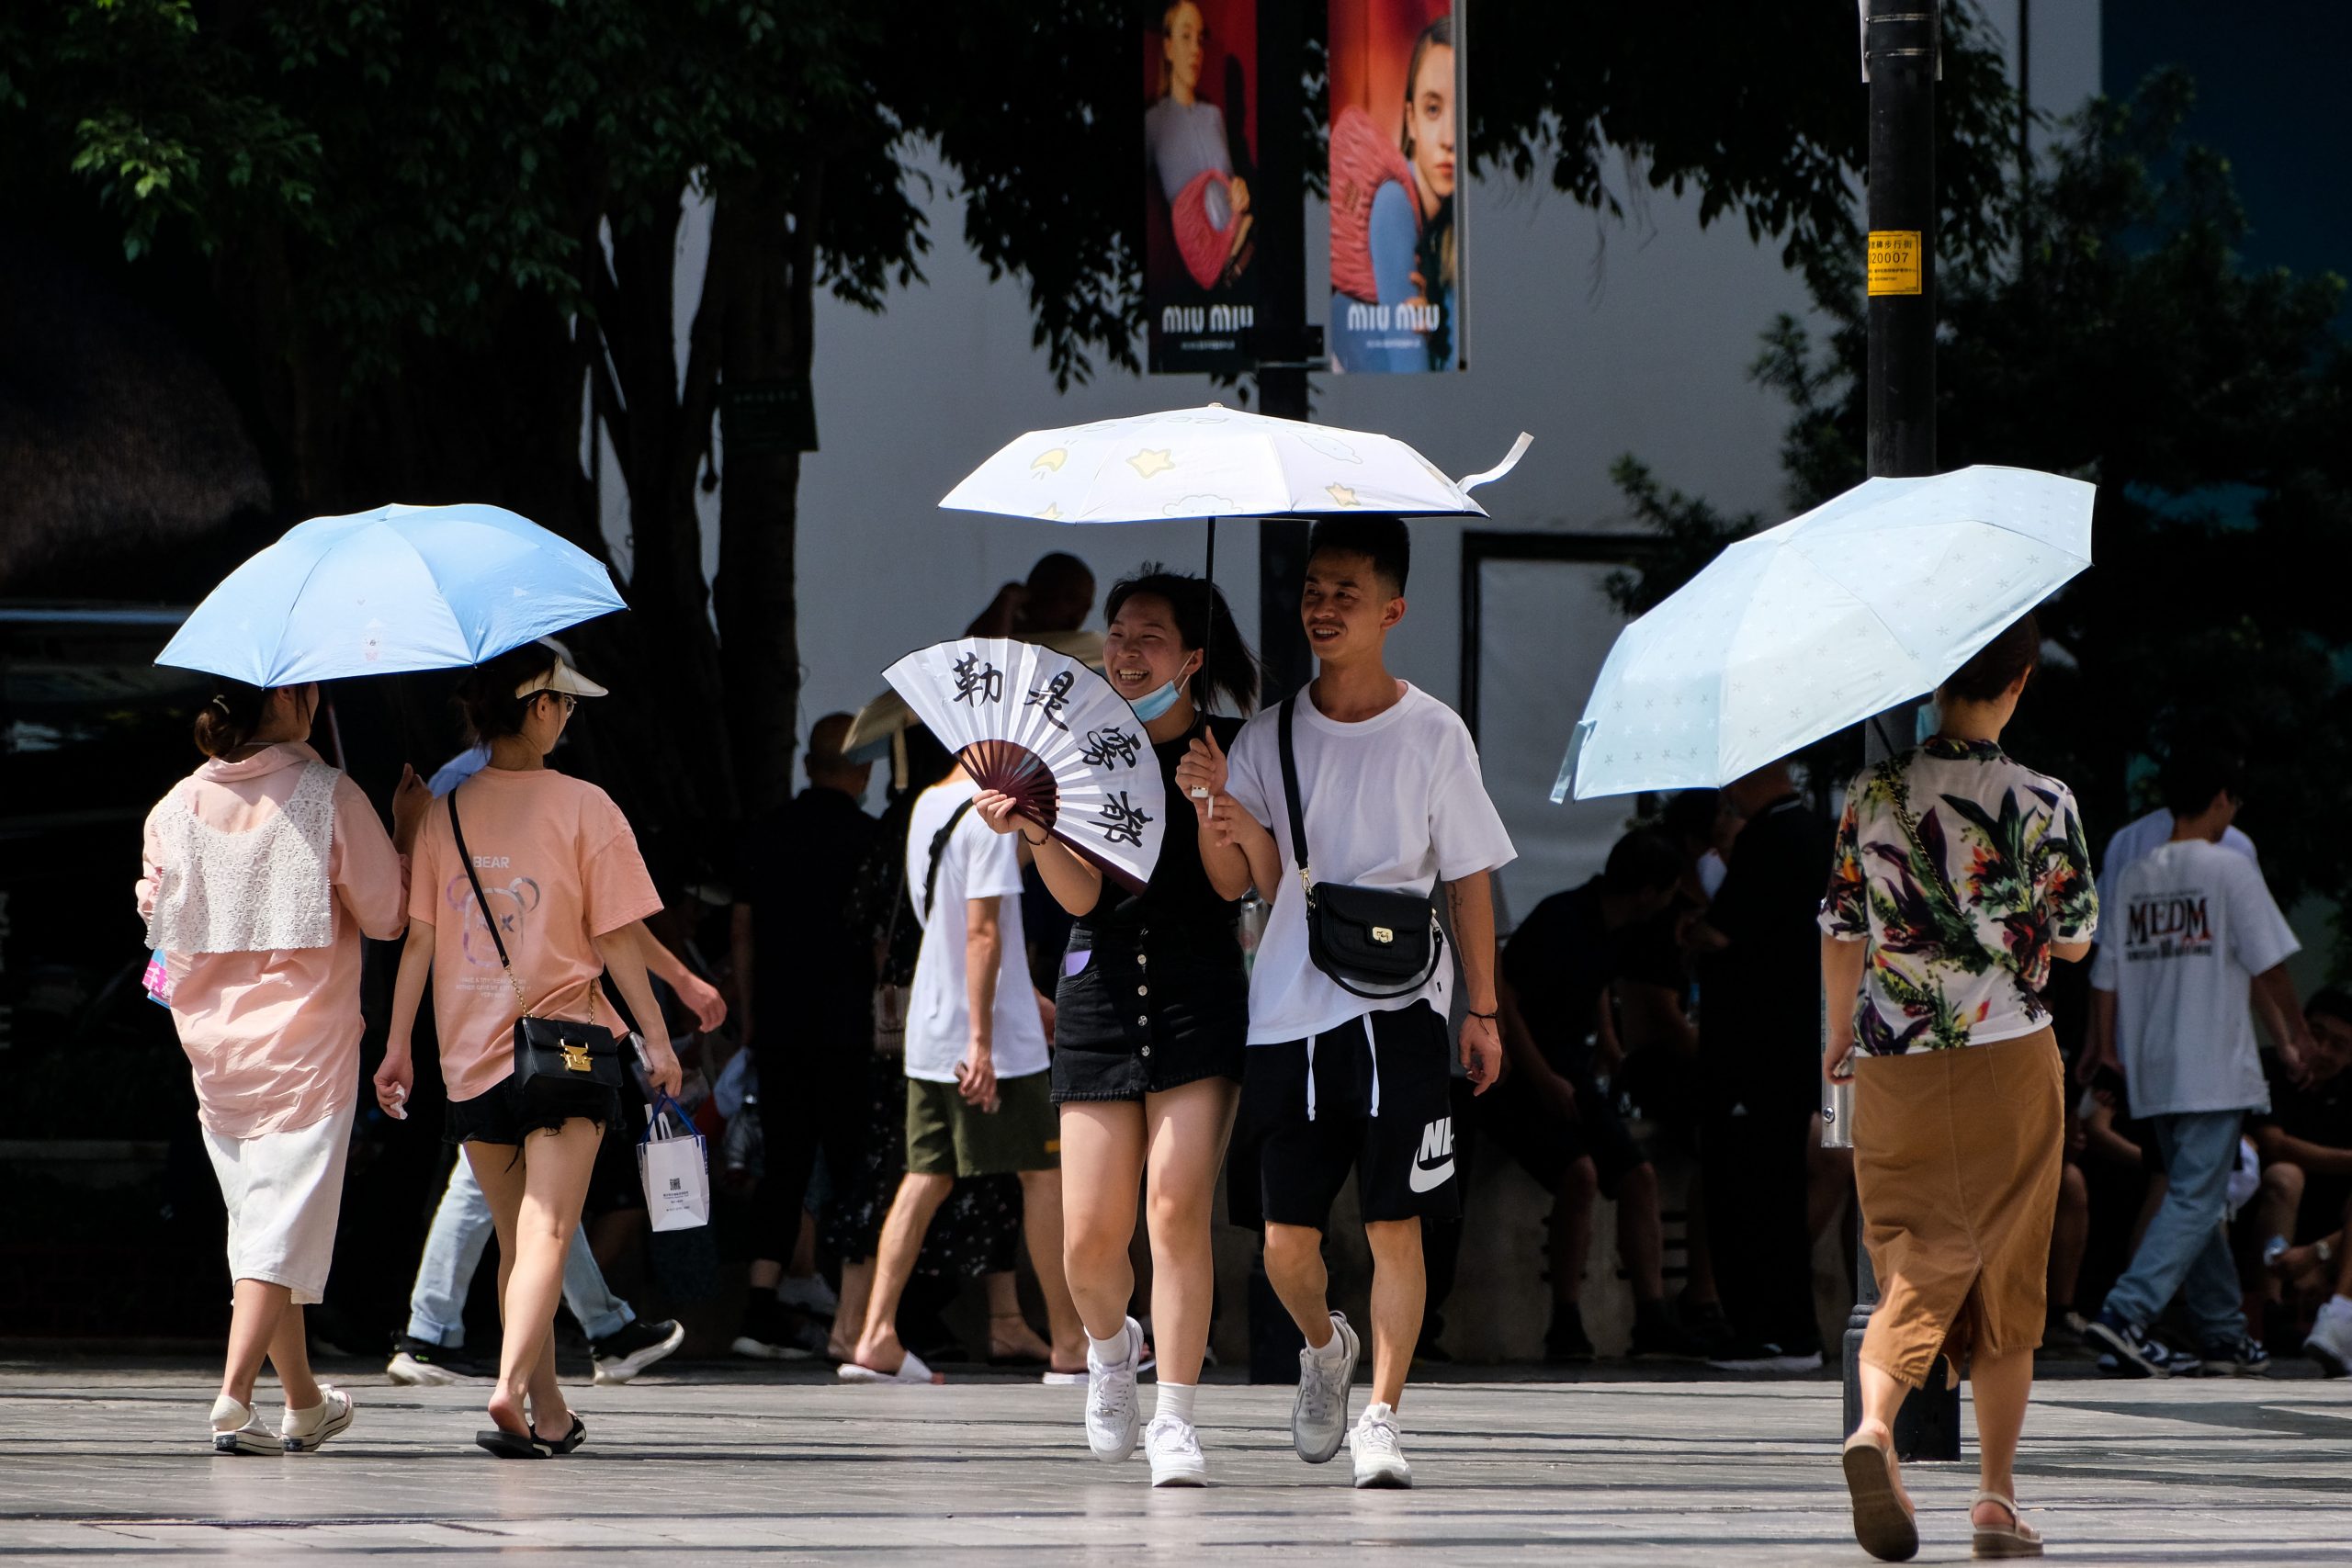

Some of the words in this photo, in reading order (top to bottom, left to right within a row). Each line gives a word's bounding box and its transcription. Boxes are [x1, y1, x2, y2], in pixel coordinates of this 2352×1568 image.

[1162, 305, 1204, 334] MIU
[1209, 304, 1254, 333] MIU
[1348, 303, 1390, 332] MIU
[1396, 303, 1440, 332] MIU
[473, 856, 510, 869] BEAR
[1419, 1116, 1454, 1162] NI
